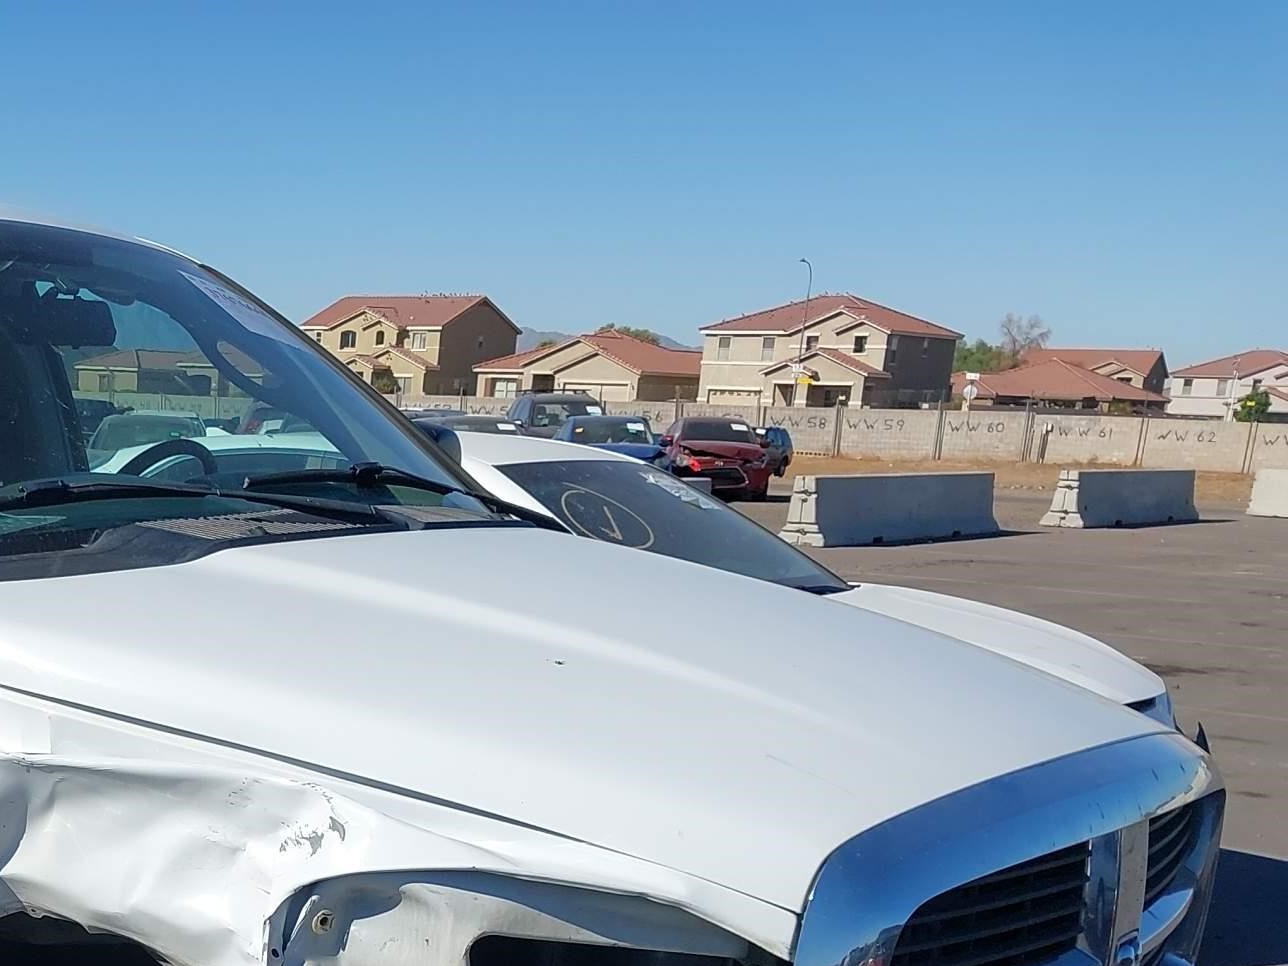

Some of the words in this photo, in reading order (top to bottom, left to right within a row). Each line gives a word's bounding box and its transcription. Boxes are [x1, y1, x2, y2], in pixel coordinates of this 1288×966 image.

[807, 416, 828, 429] 58
[883, 418, 905, 431] 59
[987, 421, 1005, 433] 60
[1098, 427, 1113, 439] 61
[1196, 431, 1217, 443] 62
[1262, 434, 1288, 446] W
